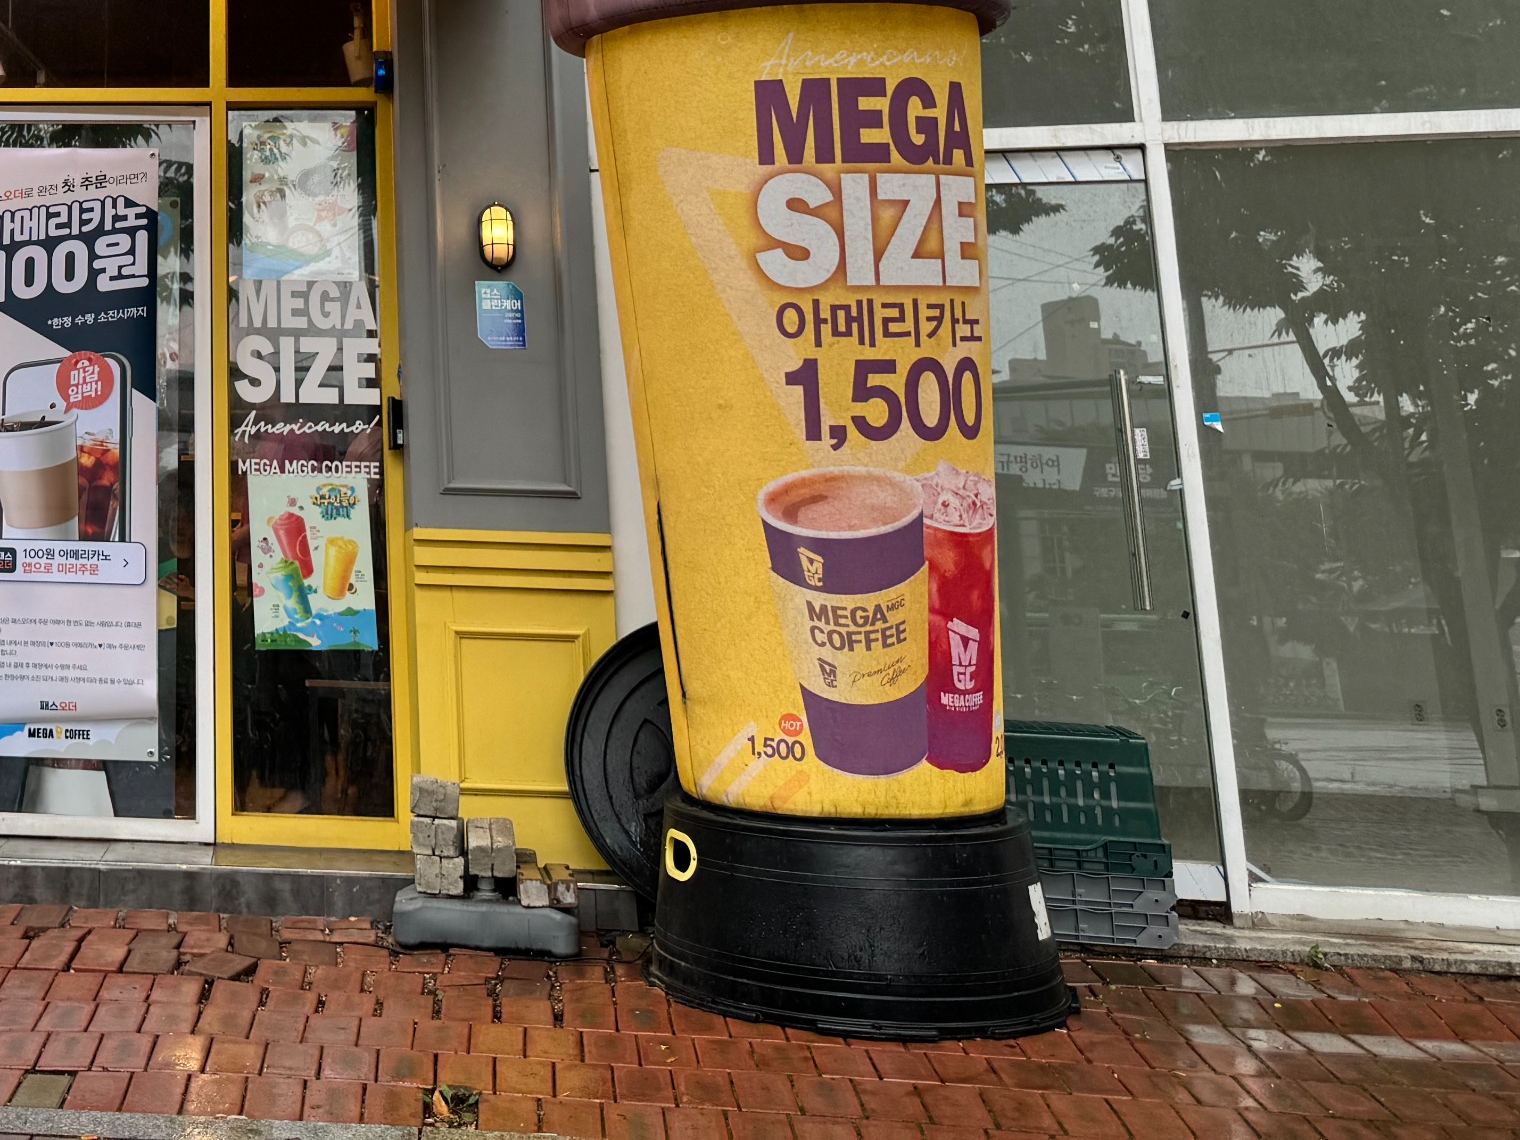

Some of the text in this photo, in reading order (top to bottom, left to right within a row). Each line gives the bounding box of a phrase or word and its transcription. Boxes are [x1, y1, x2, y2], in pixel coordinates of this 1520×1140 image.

[753, 76, 974, 167] MEGA
[37, 184, 58, 196] 완전
[62, 174, 75, 194] 첫
[80, 171, 148, 191] 주문이라면?!
[755, 172, 980, 288] SIZE
[75, 314, 94, 326] 수량
[98, 306, 147, 322] 소진시까지
[238, 280, 378, 330] MEGA
[776, 298, 983, 348] 아메리카노
[70, 366, 99, 385] 마감
[234, 334, 380, 405] SIZE
[68, 380, 102, 403] 임박!
[784, 356, 983, 452] 1,500
[234, 410, 380, 444] Americano!
[238, 458, 380, 479] MEGA MGC COFFEE
[22, 548, 111, 562] 100원 아메리카노
[22, 561, 99, 576] 앱으로 미리주문
[806, 596, 906, 629] MEGA MGC
[809, 620, 907, 652] COFFEE
[39, 700, 77, 712] 패스오더
[27, 727, 91, 741] MEGA COFFEE
[780, 720, 802, 731] HOT
[747, 735, 806, 762] 1,500
